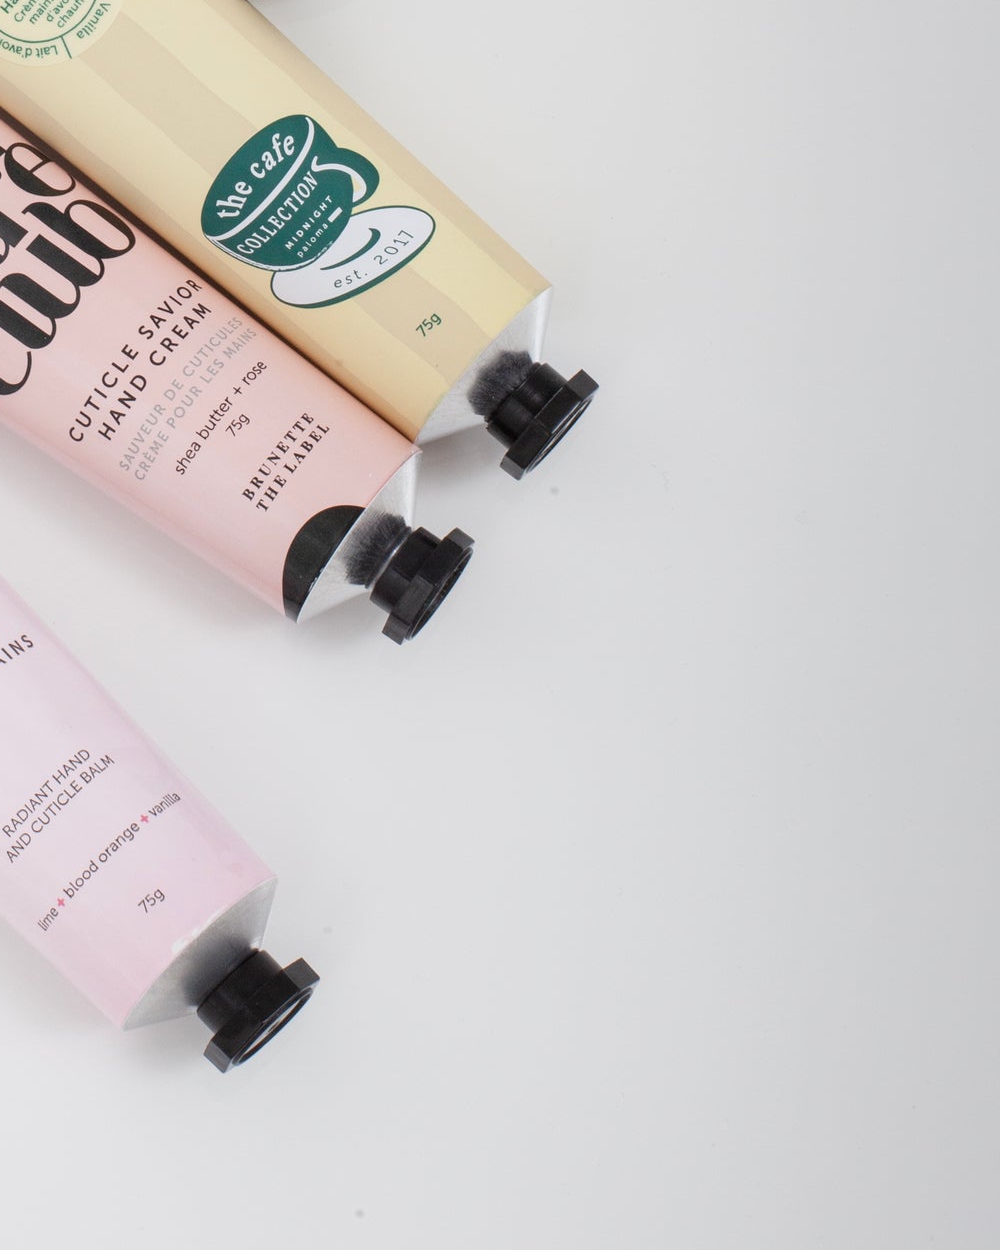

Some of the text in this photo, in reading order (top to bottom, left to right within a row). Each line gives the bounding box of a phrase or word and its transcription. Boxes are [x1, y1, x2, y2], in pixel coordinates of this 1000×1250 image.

[35, 45, 58, 58] Lait
[76, 3, 111, 39] Vanilla
[216, 133, 295, 219] the cafe
[236, 171, 318, 255] COLLECTION
[285, 195, 333, 250] MIDNIGHT
[297, 222, 328, 258] paloma
[334, 229, 414, 288] est. 2017
[69, 279, 202, 442] CUTICLE SAVIOR
[416, 312, 442, 337] 75g
[98, 303, 212, 441] HAND CREAM
[119, 317, 243, 471] SAUVEUR DE CUTICULES
[166, 389, 203, 429] POUR
[202, 358, 224, 384] LES
[224, 327, 257, 358] MAINS
[175, 360, 267, 476] shea butter + rose
[225, 413, 251, 438] 75g
[241, 412, 314, 501] BRUNETTE
[256, 423, 330, 512] THE LABEL
[2, 749, 90, 838] RADIANT HAND
[6, 754, 115, 863] AND CUTICLE BALM
[38, 907, 59, 931] lime
[63, 860, 99, 899] blood
[99, 822, 140, 863] orange
[148, 791, 181, 817] vanilla
[138, 888, 166, 913] 75g
